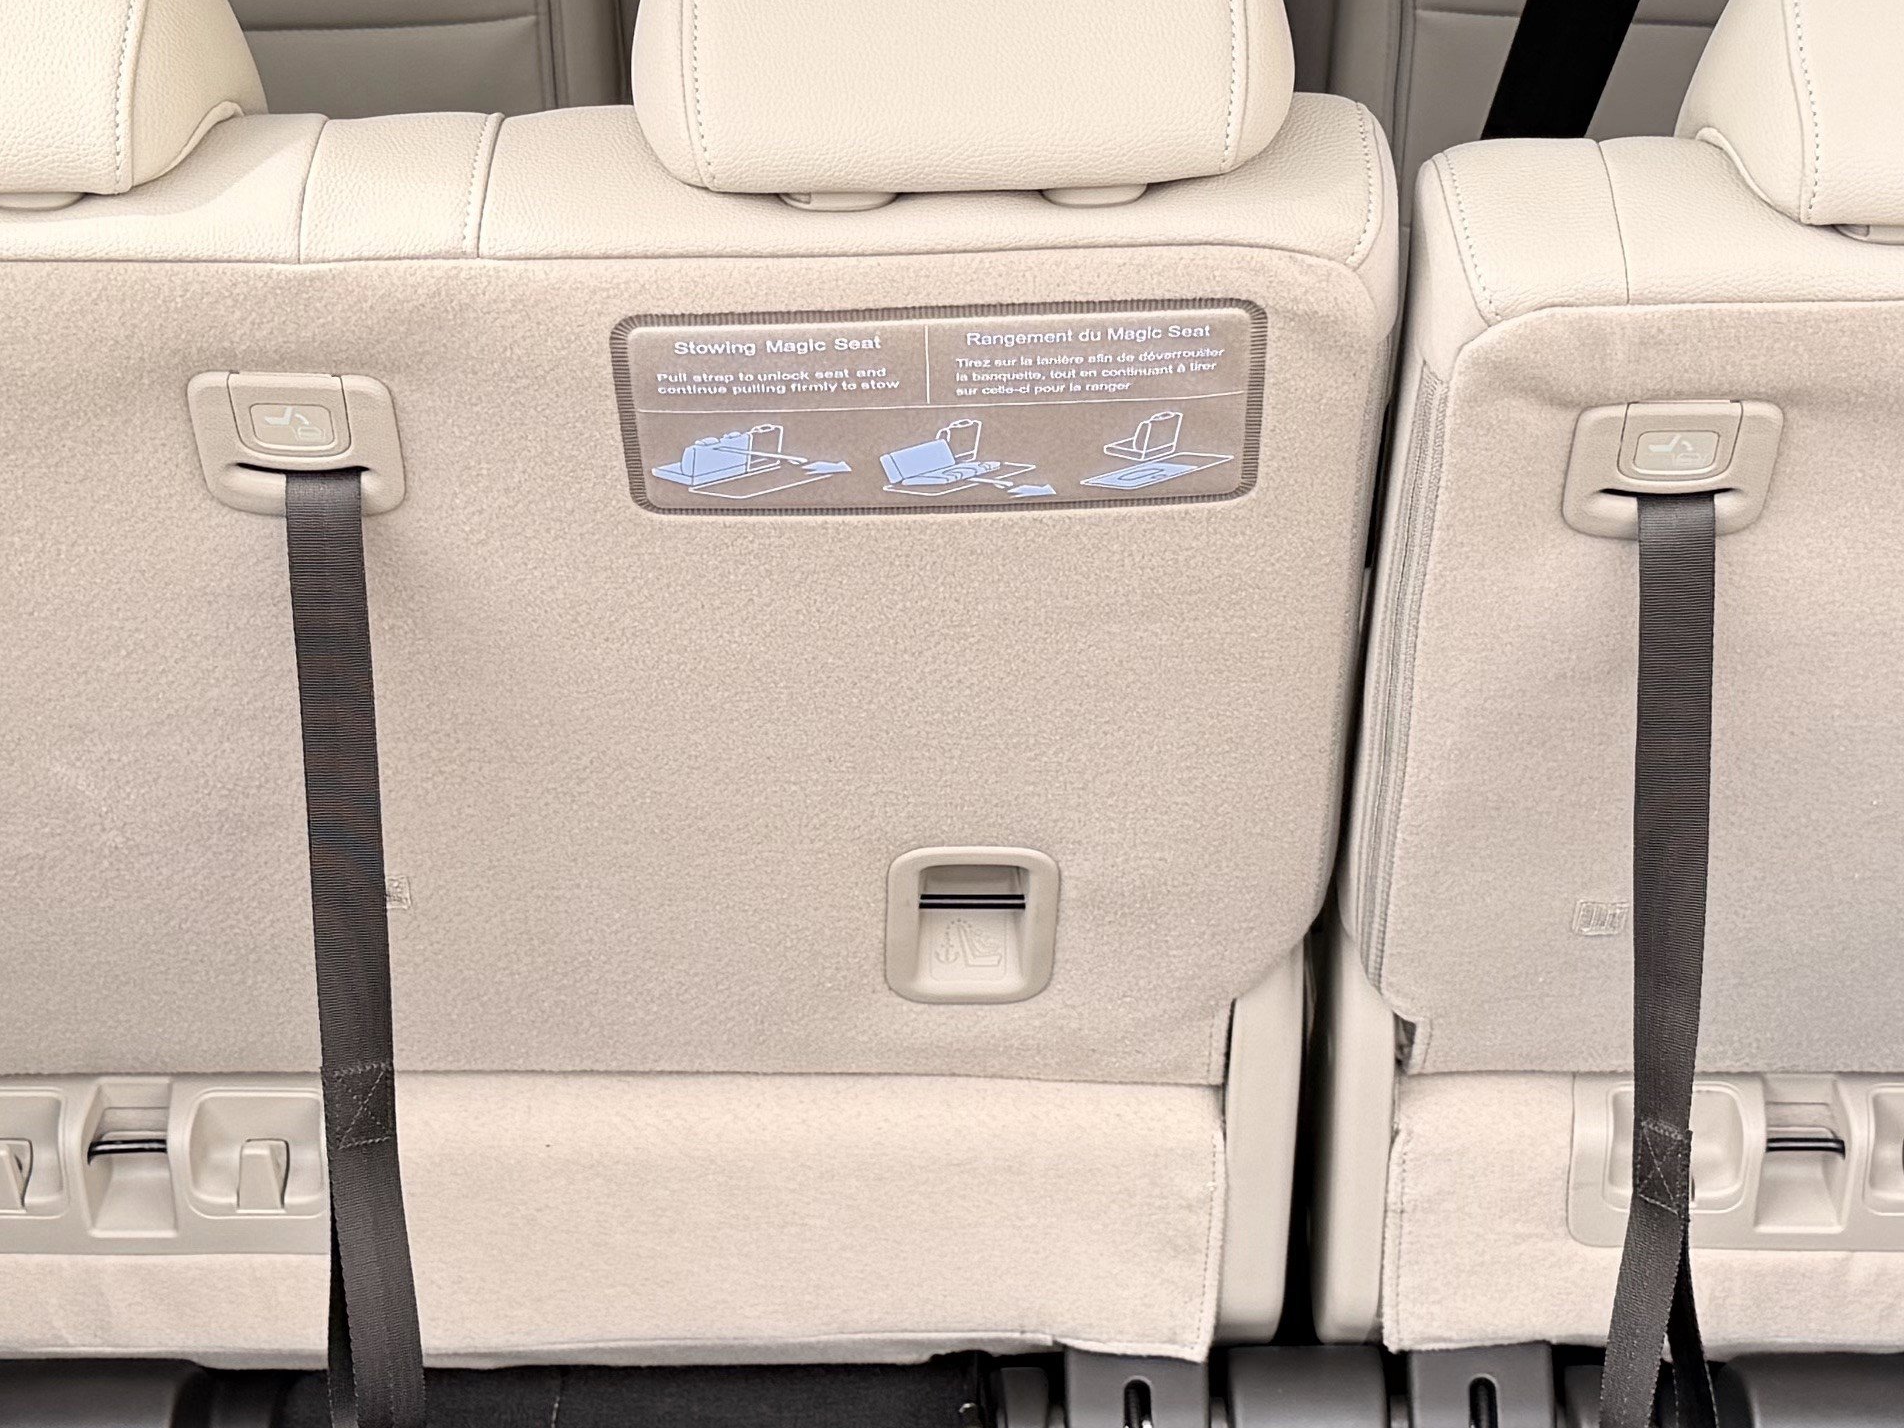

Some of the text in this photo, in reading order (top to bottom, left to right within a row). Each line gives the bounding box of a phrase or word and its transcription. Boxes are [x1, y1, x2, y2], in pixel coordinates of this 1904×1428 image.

[966, 324, 1210, 347] Rangement du Magic Seat
[674, 335, 881, 356] Stowing Magic Seat
[955, 357, 991, 368] Tirez
[995, 359, 1017, 367] sur
[1020, 356, 1033, 366] la
[1088, 354, 1113, 363] afin
[1117, 352, 1135, 362] de
[656, 367, 887, 384] Pull strap to unlock seat and
[956, 372, 968, 382] la
[1050, 368, 1076, 379] tout
[1101, 364, 1173, 377] continuant
[657, 380, 900, 395] continue pulling firmly to stow
[956, 387, 978, 396] sur
[1034, 384, 1066, 395] pour
[1070, 383, 1081, 392] la
